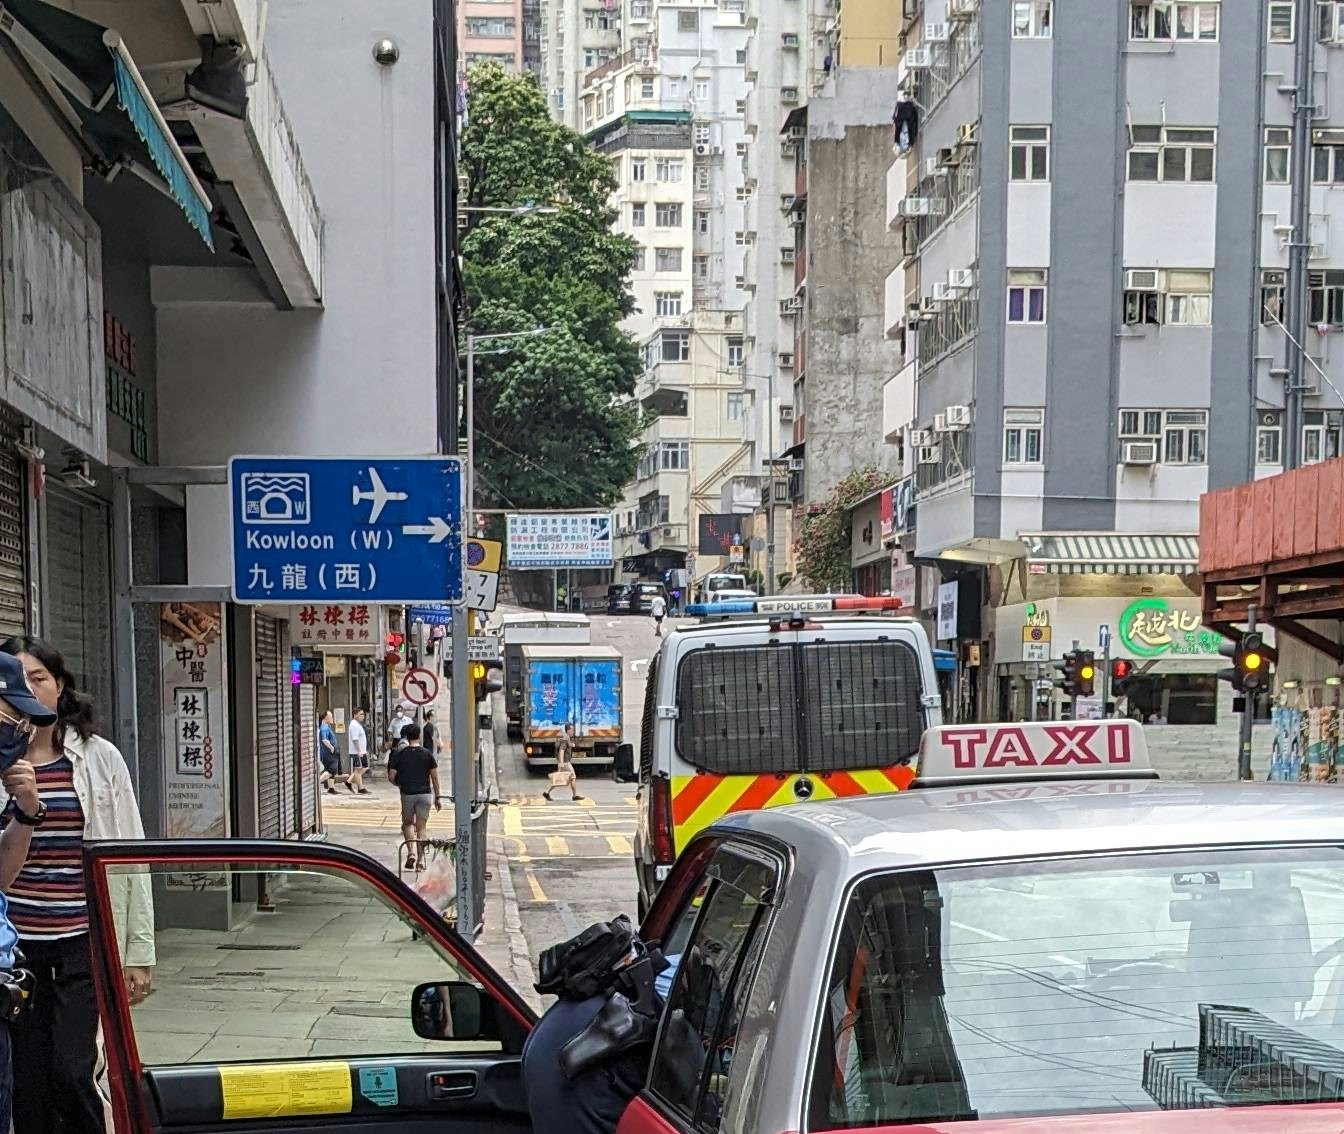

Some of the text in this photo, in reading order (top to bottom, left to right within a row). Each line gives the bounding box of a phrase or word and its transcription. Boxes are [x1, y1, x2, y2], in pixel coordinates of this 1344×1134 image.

[294, 501, 306, 515] W
[246, 529, 394, 550] Kowloon (W)
[479, 574, 488, 587] 7
[477, 594, 486, 607] 7
[776, 601, 813, 611] POLICE
[181, 695, 203, 767] 林棟樑
[941, 724, 1131, 768] TAXI
